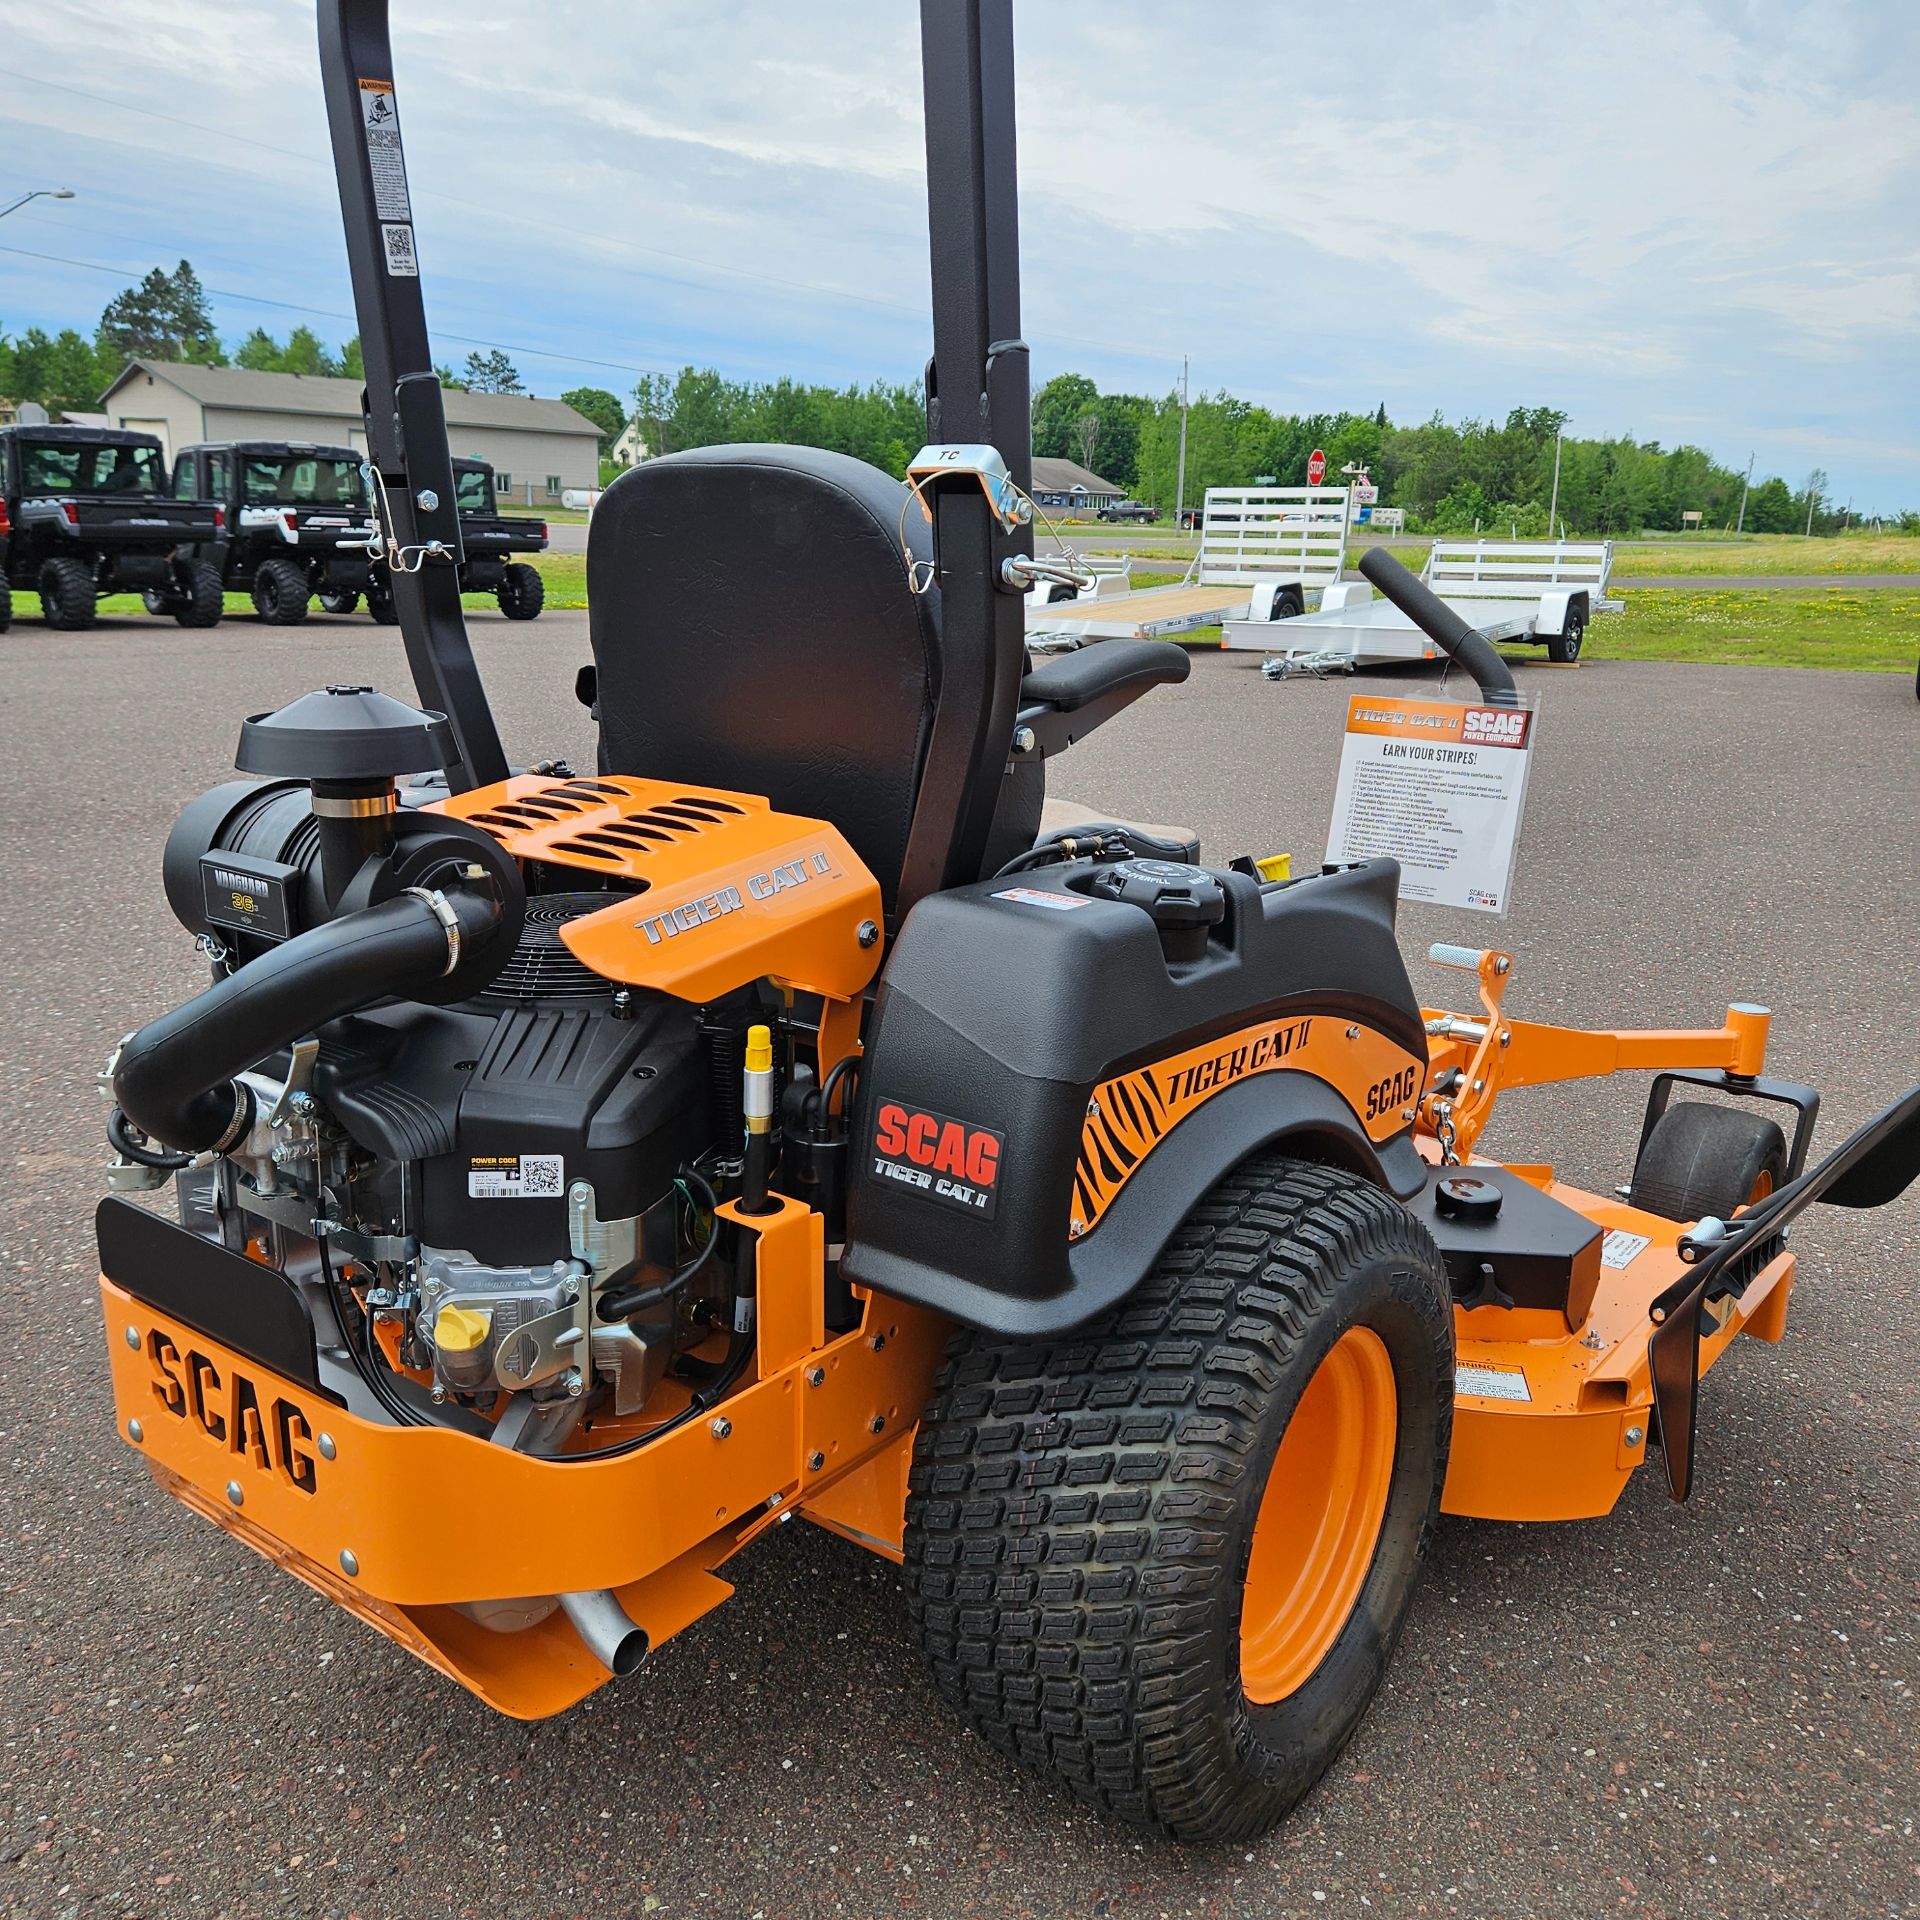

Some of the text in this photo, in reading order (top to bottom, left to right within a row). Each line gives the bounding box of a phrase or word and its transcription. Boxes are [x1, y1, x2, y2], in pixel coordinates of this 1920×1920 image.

[938, 450, 960, 460] TC
[1309, 461, 1325, 475] STOP
[1353, 708, 1407, 725] TIGER
[1410, 713, 1448, 728] CAT
[1465, 710, 1523, 736] SCAG
[1463, 730, 1522, 744] POWER EQUIPMENT
[1383, 743, 1478, 765] EARN YOUR STRIPES!
[215, 869, 269, 898] VANGUARD
[231, 892, 254, 912] 36
[634, 886, 744, 945] TIGER
[810, 852, 832, 875] II
[1167, 1018, 1312, 1105] TIGER CAT II
[1365, 1066, 1416, 1122] SCAG
[876, 1104, 1000, 1186] SCAG
[874, 1157, 933, 1189] TIGER
[975, 1193, 988, 1208] II
[1457, 1361, 1496, 1371] RNING
[147, 1328, 317, 1500] SCAG
